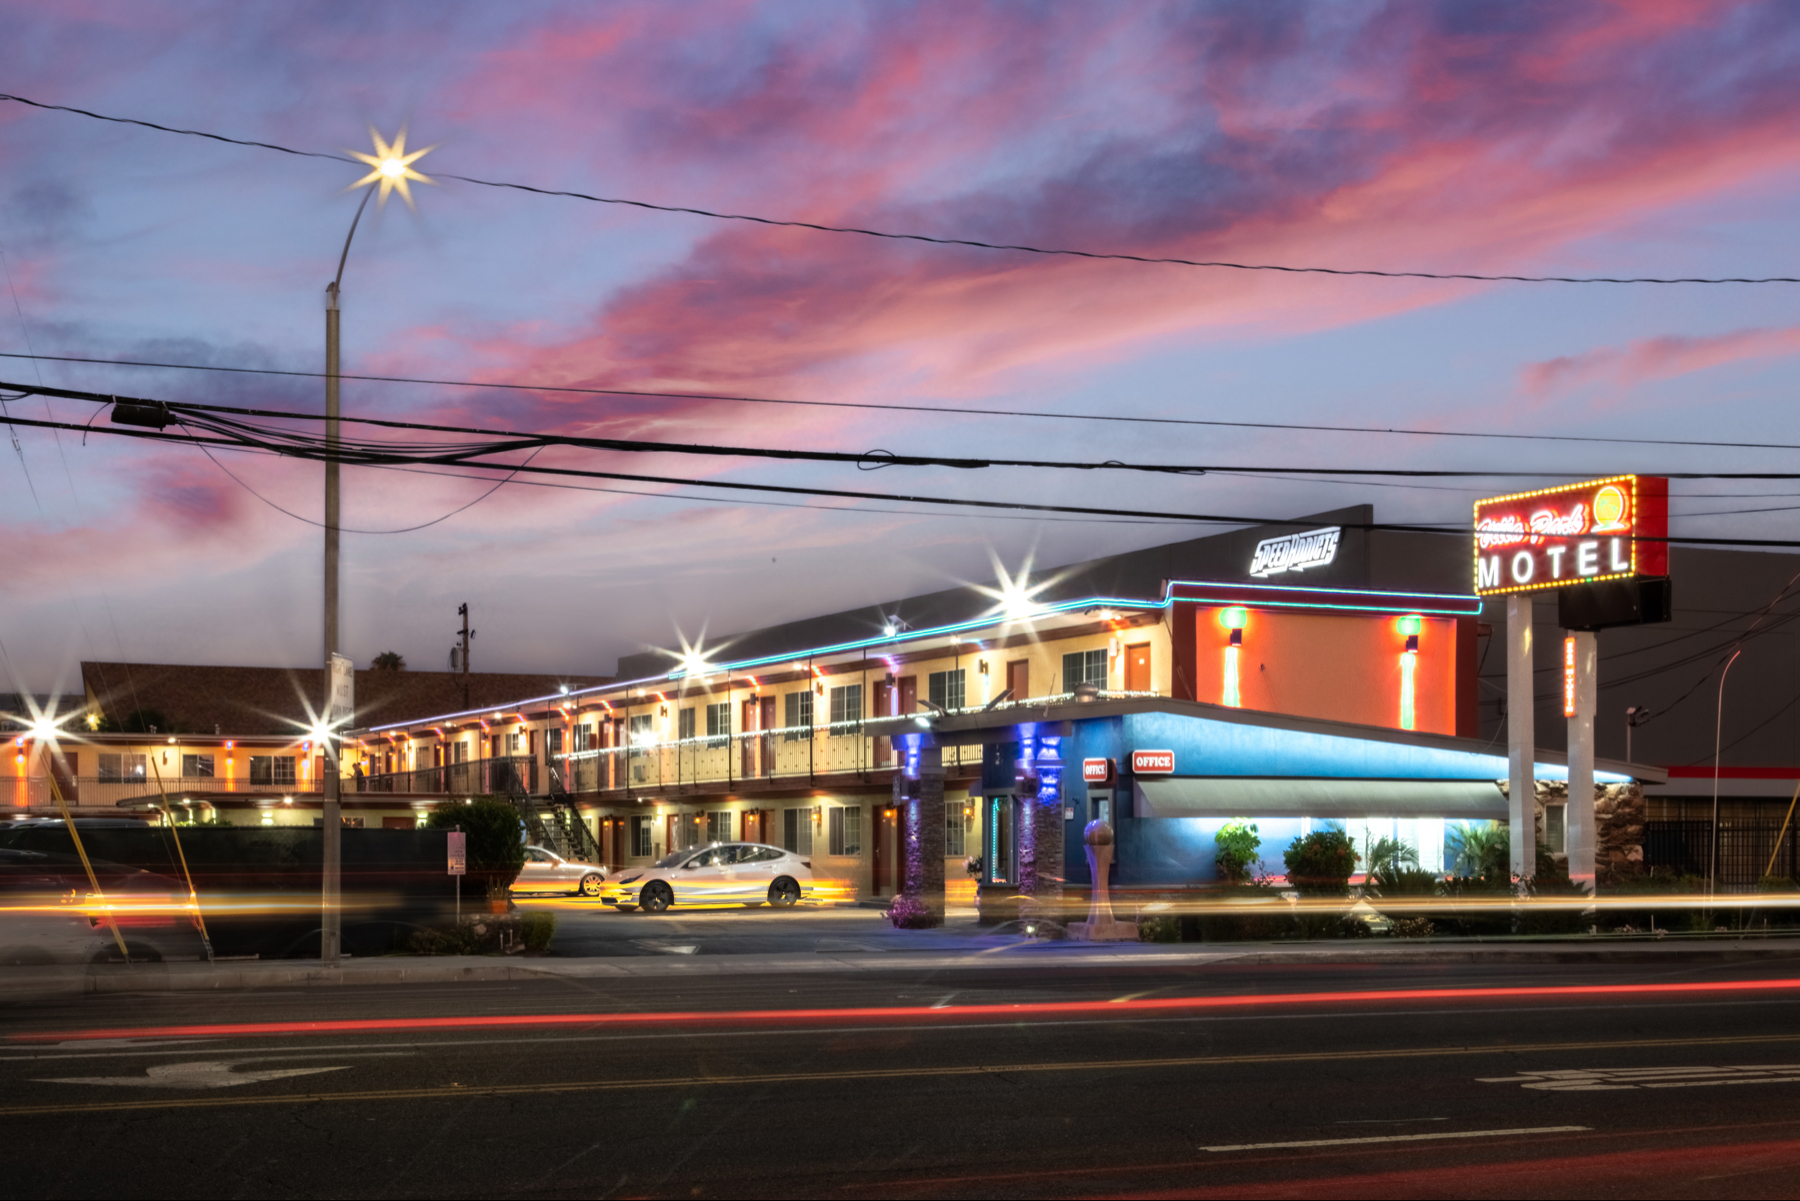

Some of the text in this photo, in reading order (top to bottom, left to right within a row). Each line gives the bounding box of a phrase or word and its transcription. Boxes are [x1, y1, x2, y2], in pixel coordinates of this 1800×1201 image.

[1530, 504, 1585, 545] Park
[1477, 538, 1629, 589] MOTEL
[1085, 764, 1106, 776] OFFICE
[1136, 756, 1171, 768] OFFICE
